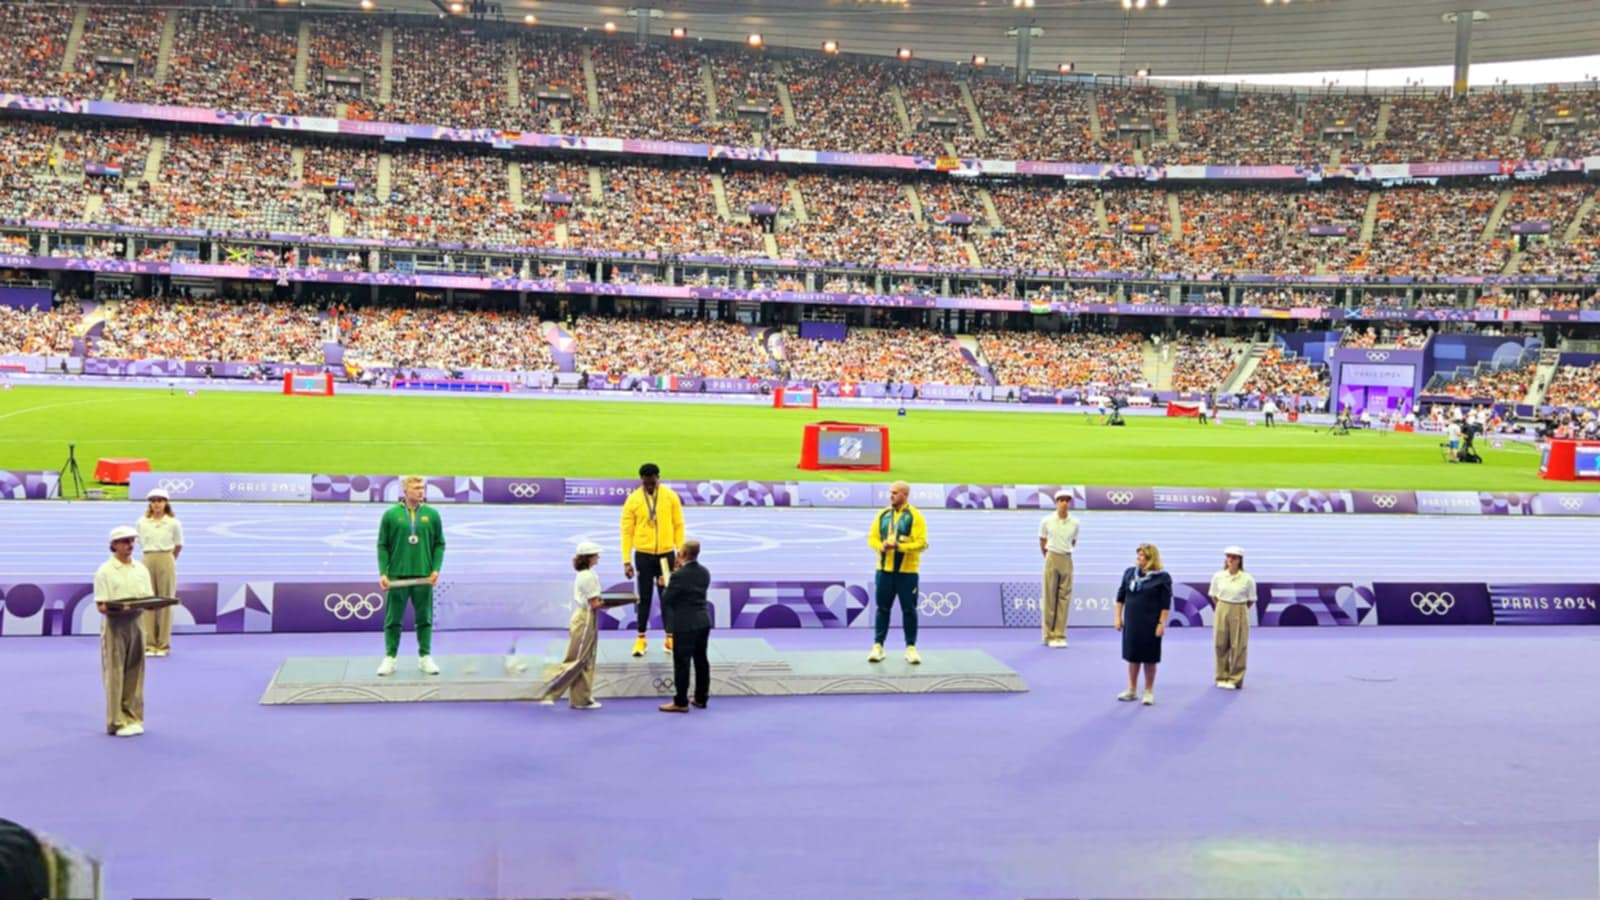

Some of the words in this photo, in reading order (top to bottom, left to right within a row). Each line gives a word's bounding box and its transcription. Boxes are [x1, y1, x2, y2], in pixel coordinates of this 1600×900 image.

[229, 482, 266, 492] PARIS
[271, 483, 305, 492] 2024
[571, 487, 605, 496] PARIS
[609, 487, 636, 496] 202
[1159, 494, 1189, 502] PARIS
[1192, 495, 1217, 504] 2024
[1074, 598, 1110, 610] 202
[1500, 597, 1549, 609] PARIS
[1553, 597, 1596, 609] 2024
